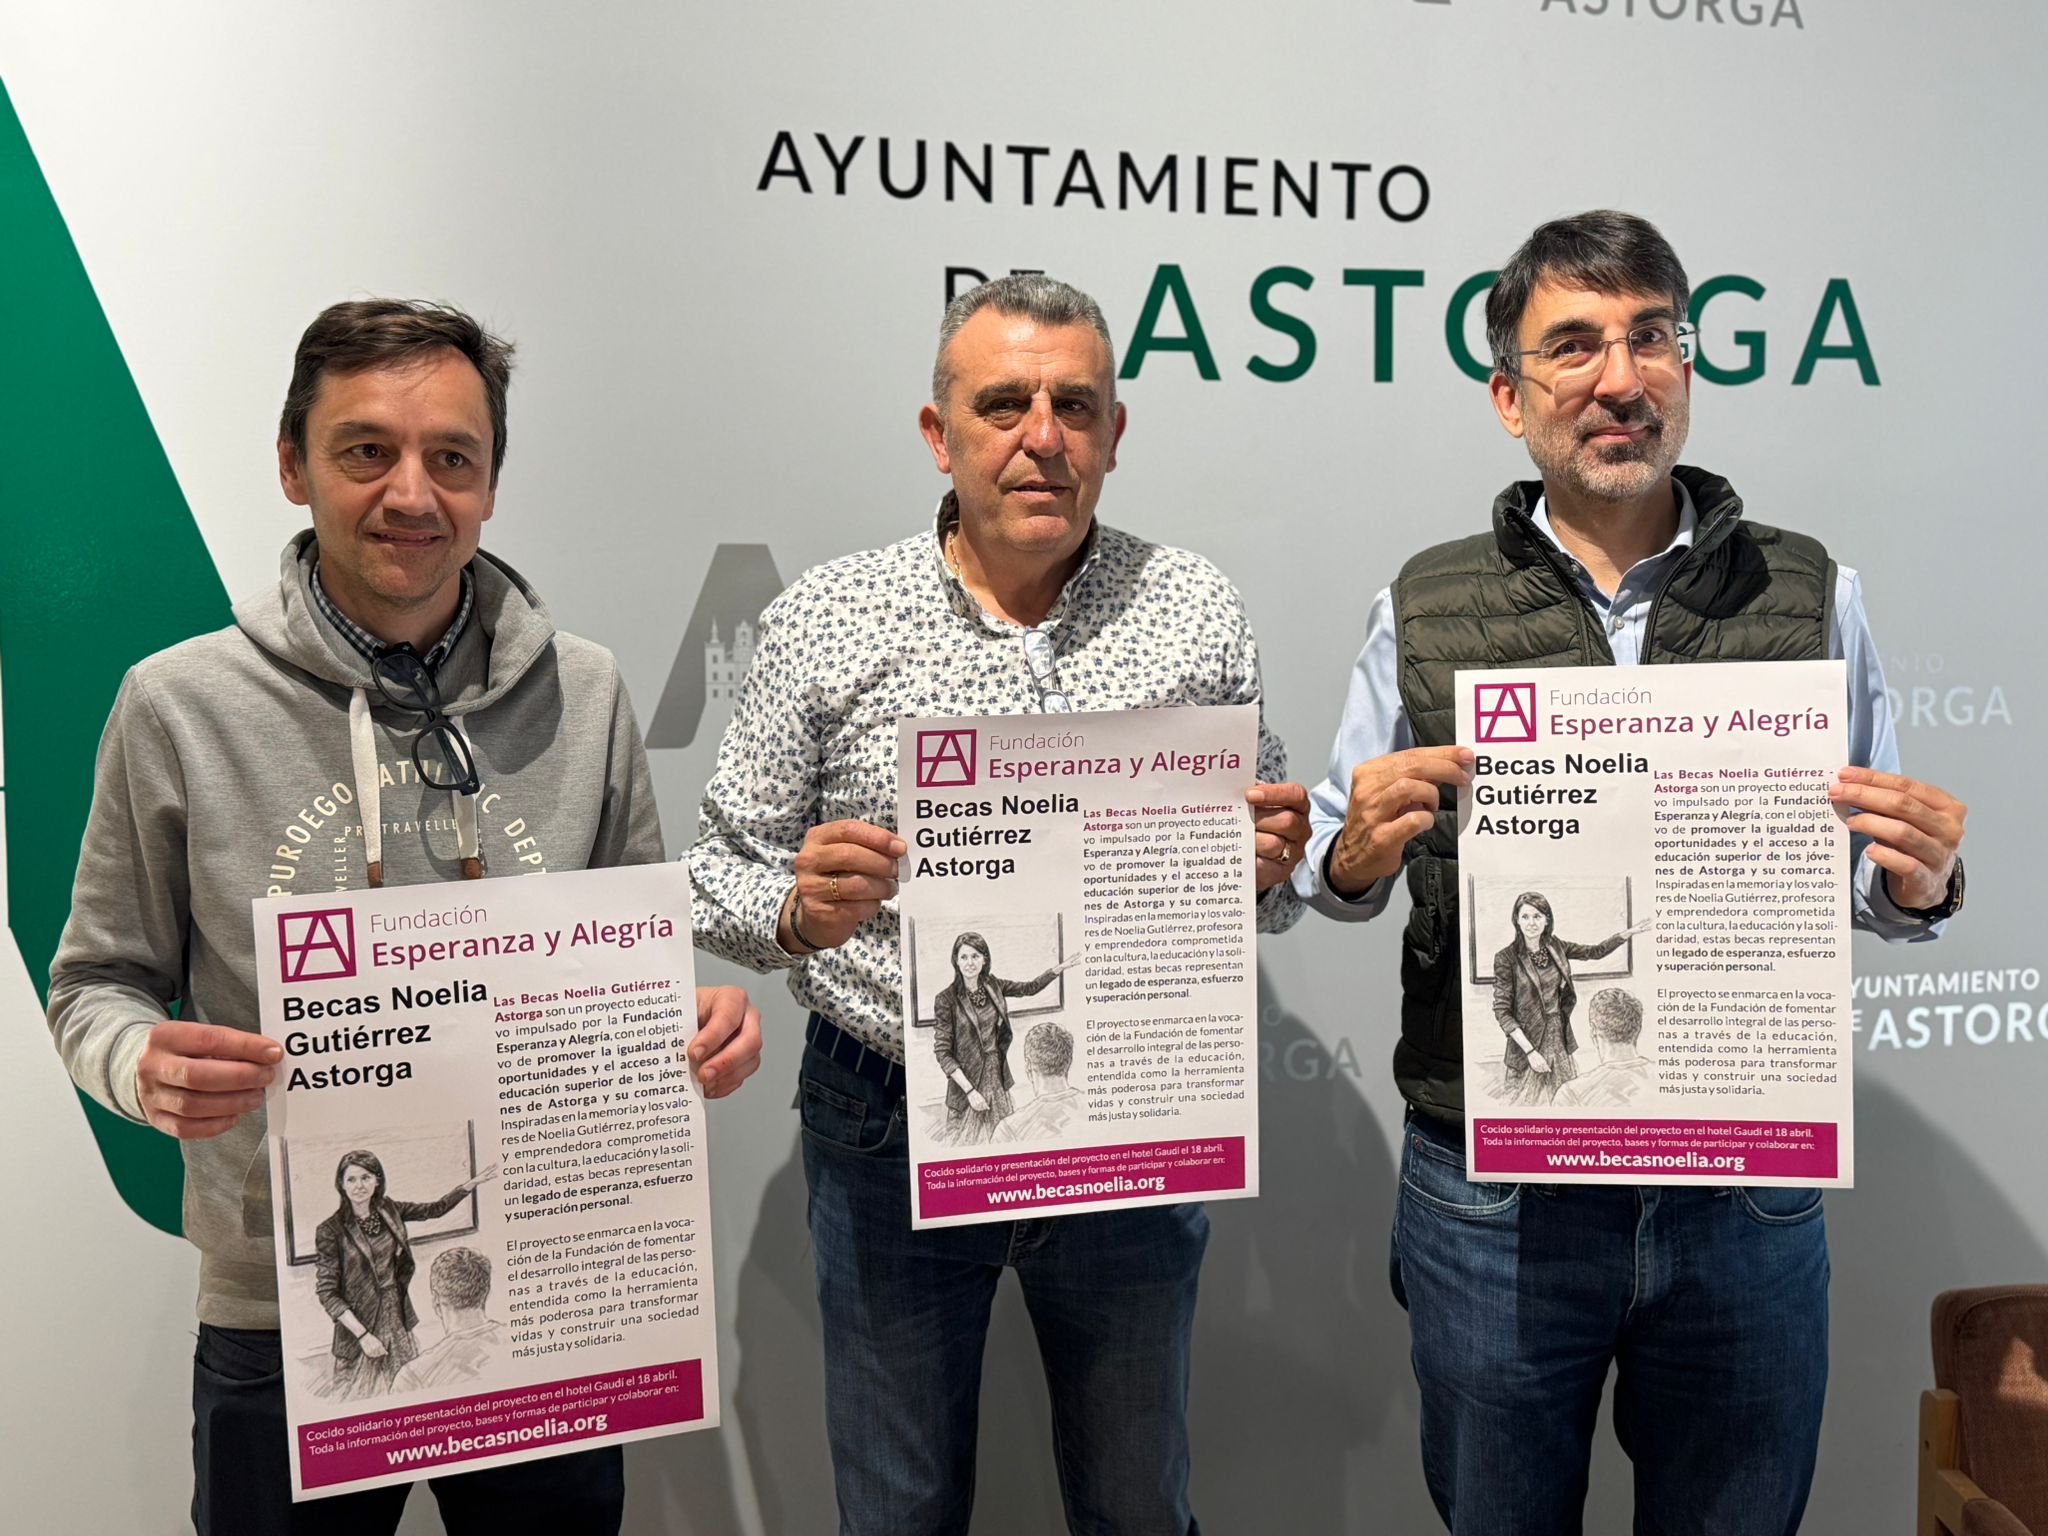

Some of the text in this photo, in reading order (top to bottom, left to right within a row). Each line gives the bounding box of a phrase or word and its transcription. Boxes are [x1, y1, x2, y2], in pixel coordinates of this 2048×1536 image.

[756, 130, 1431, 223] AYUNTAMIENTO
[1117, 263, 1882, 387] ASTGA
[1549, 685, 1652, 706] Fundación
[1549, 705, 1829, 741] Esperanza y Alegría
[989, 731, 1084, 751] Fundación
[988, 747, 1241, 784] Esperanza y Alegría
[1473, 751, 1649, 776] Becas Noelia
[914, 792, 1079, 820] Becas Noelia
[1474, 782, 1598, 806] Gutiérrez
[266, 782, 354, 898] PUROEGO
[381, 818, 457, 835] TRAVELLE
[914, 824, 1032, 849] Gutiérrez
[1474, 813, 1580, 840] Astorga
[1653, 835, 1835, 850] oportunidades y el acceso a la
[1653, 849, 1835, 864] educación superior de los jóve-
[914, 855, 1015, 880] Astorga
[1653, 864, 1835, 878] nes de Astorga y su comarca.
[370, 904, 488, 933] Fundación
[371, 912, 673, 971] Esperanza y Alegría
[492, 995, 516, 1008] Las
[519, 991, 559, 1005] Becas
[563, 984, 606, 1000] Noelia
[609, 978, 671, 995] Gutiérrez
[1851, 967, 2040, 999] YUNTAMIENTO
[281, 978, 488, 1022] Becas Noelia
[493, 990, 682, 1024] Astorga son un proyecto educati-
[494, 1005, 683, 1039] vo impulsado por la Fundación
[1868, 1001, 2048, 1051] ASTOR
[283, 1023, 432, 1057] Gutiérrez
[495, 1020, 683, 1055] Esperanza y Alegría, con el objeti-
[495, 1035, 685, 1070] vo de promover la igualdad de
[496, 1050, 687, 1086] oportunidades y el acceso a la
[1085, 1063, 1245, 1083] entendida como la herramienta
[1086, 1050, 1245, 1070] nas a través de la educación,
[285, 1060, 413, 1092] Astorga
[497, 1067, 687, 1100] educación superior de los jóve-
[1086, 1077, 1245, 1096] más poderosa para transformar
[498, 1083, 689, 1116] nes de Astorga y su comarca.
[1086, 1088, 1245, 1109] vidas y construir una sociedad
[1480, 1135, 1815, 1150] Toda la información del proyecto, bases y formas de participar y colaborar en:
[1545, 1149, 1746, 1172] www.becasnoelia.org
[985, 1174, 1166, 1204] www.becasnoelia.org
[304, 1368, 678, 1442] Cocido solidario y presentación del proyecto en el hotel Gaudí el 18 abril.
[384, 1412, 608, 1465] www.becasnoelia.org
